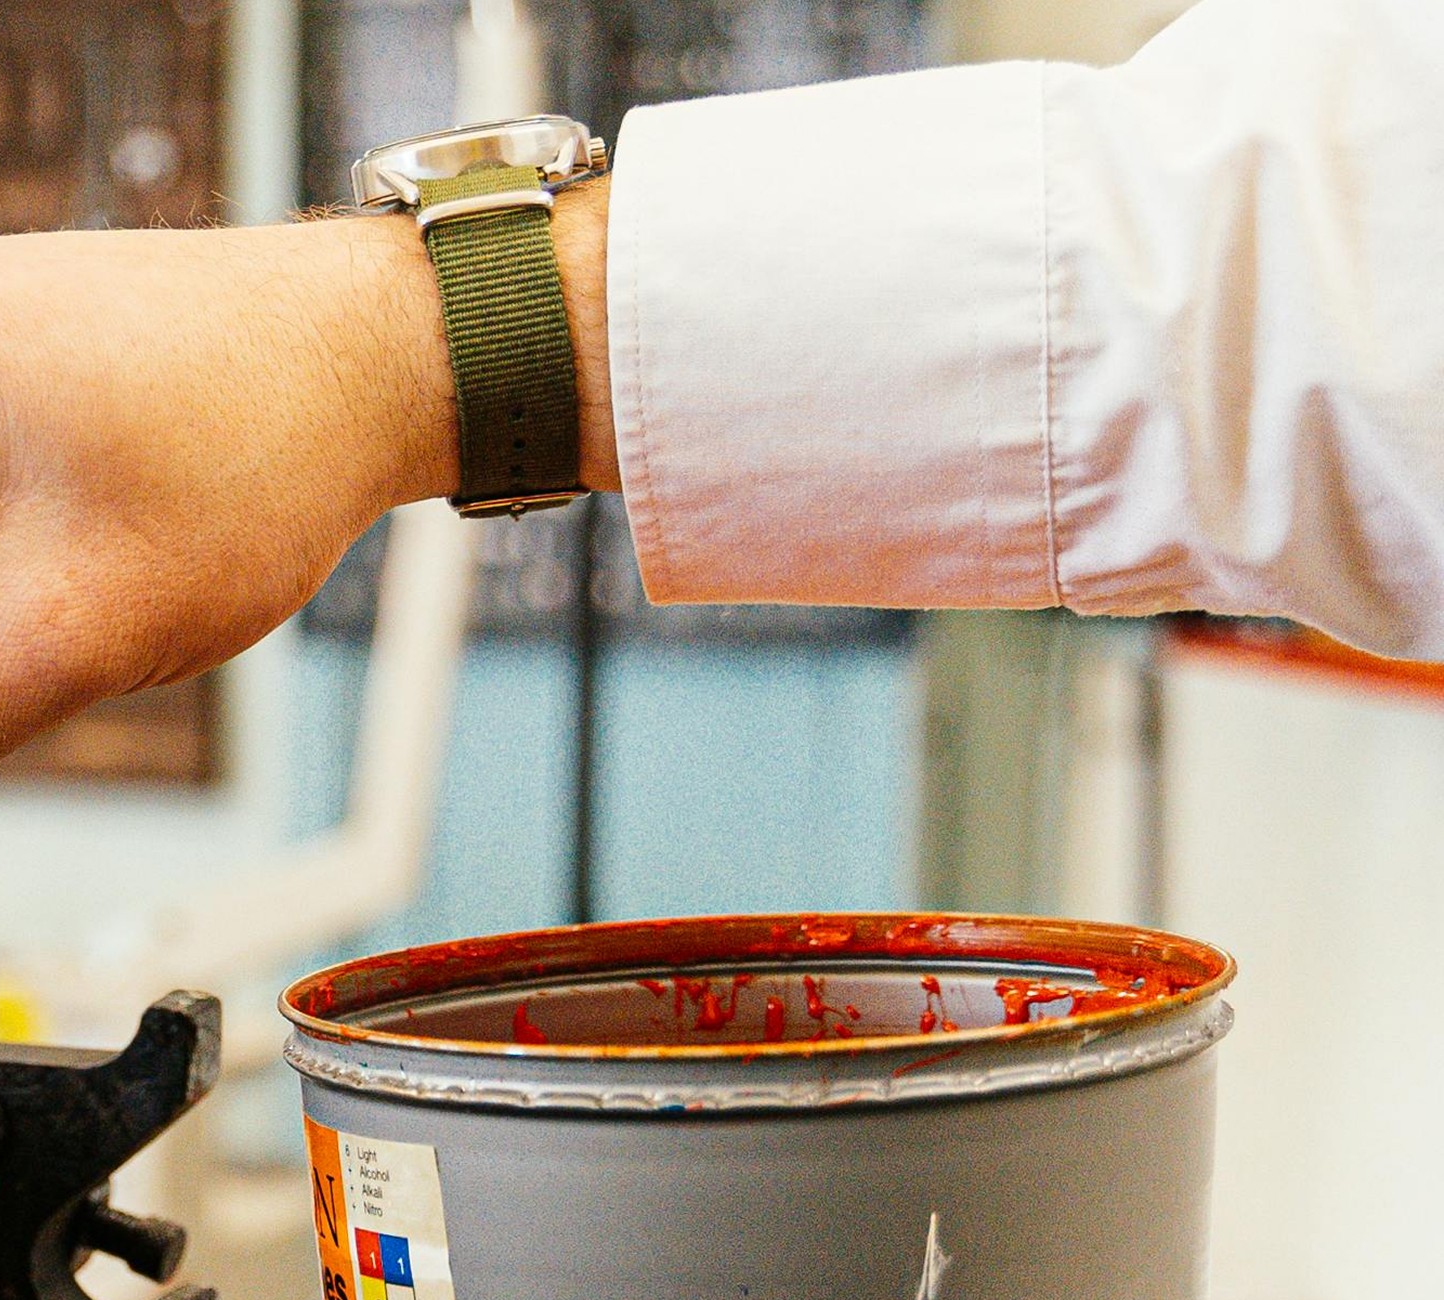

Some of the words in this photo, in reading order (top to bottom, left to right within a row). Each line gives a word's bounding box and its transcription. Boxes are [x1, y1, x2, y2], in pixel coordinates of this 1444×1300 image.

[357, 1146, 377, 1164] Light
[360, 1165, 390, 1182] Alcohol
[362, 1184, 383, 1198] Alkali
[364, 1201, 383, 1217] Nitro
[369, 1252, 377, 1270] 1
[397, 1258, 405, 1275] 1
